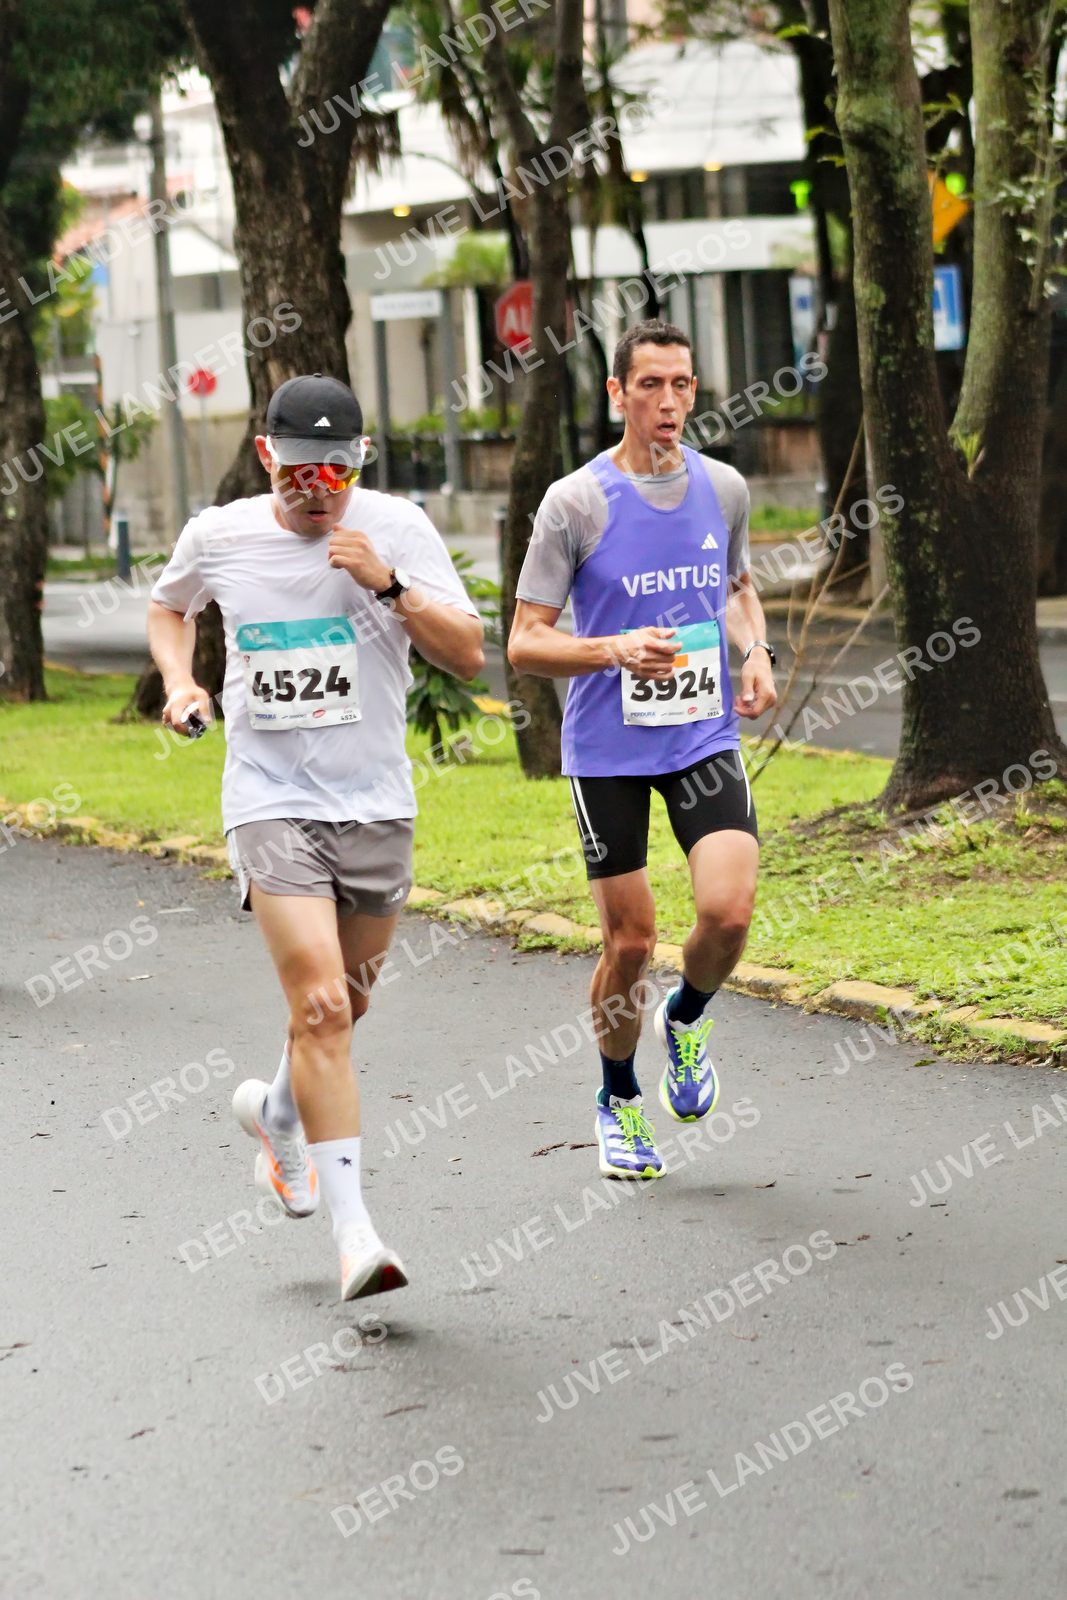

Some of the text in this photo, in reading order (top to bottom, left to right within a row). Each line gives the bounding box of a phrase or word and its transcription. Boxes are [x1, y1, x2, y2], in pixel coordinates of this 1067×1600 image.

[502, 305, 532, 337] AL
[621, 563, 721, 597] VENTUS
[252, 665, 351, 703] 4524
[630, 667, 715, 702] 3924
